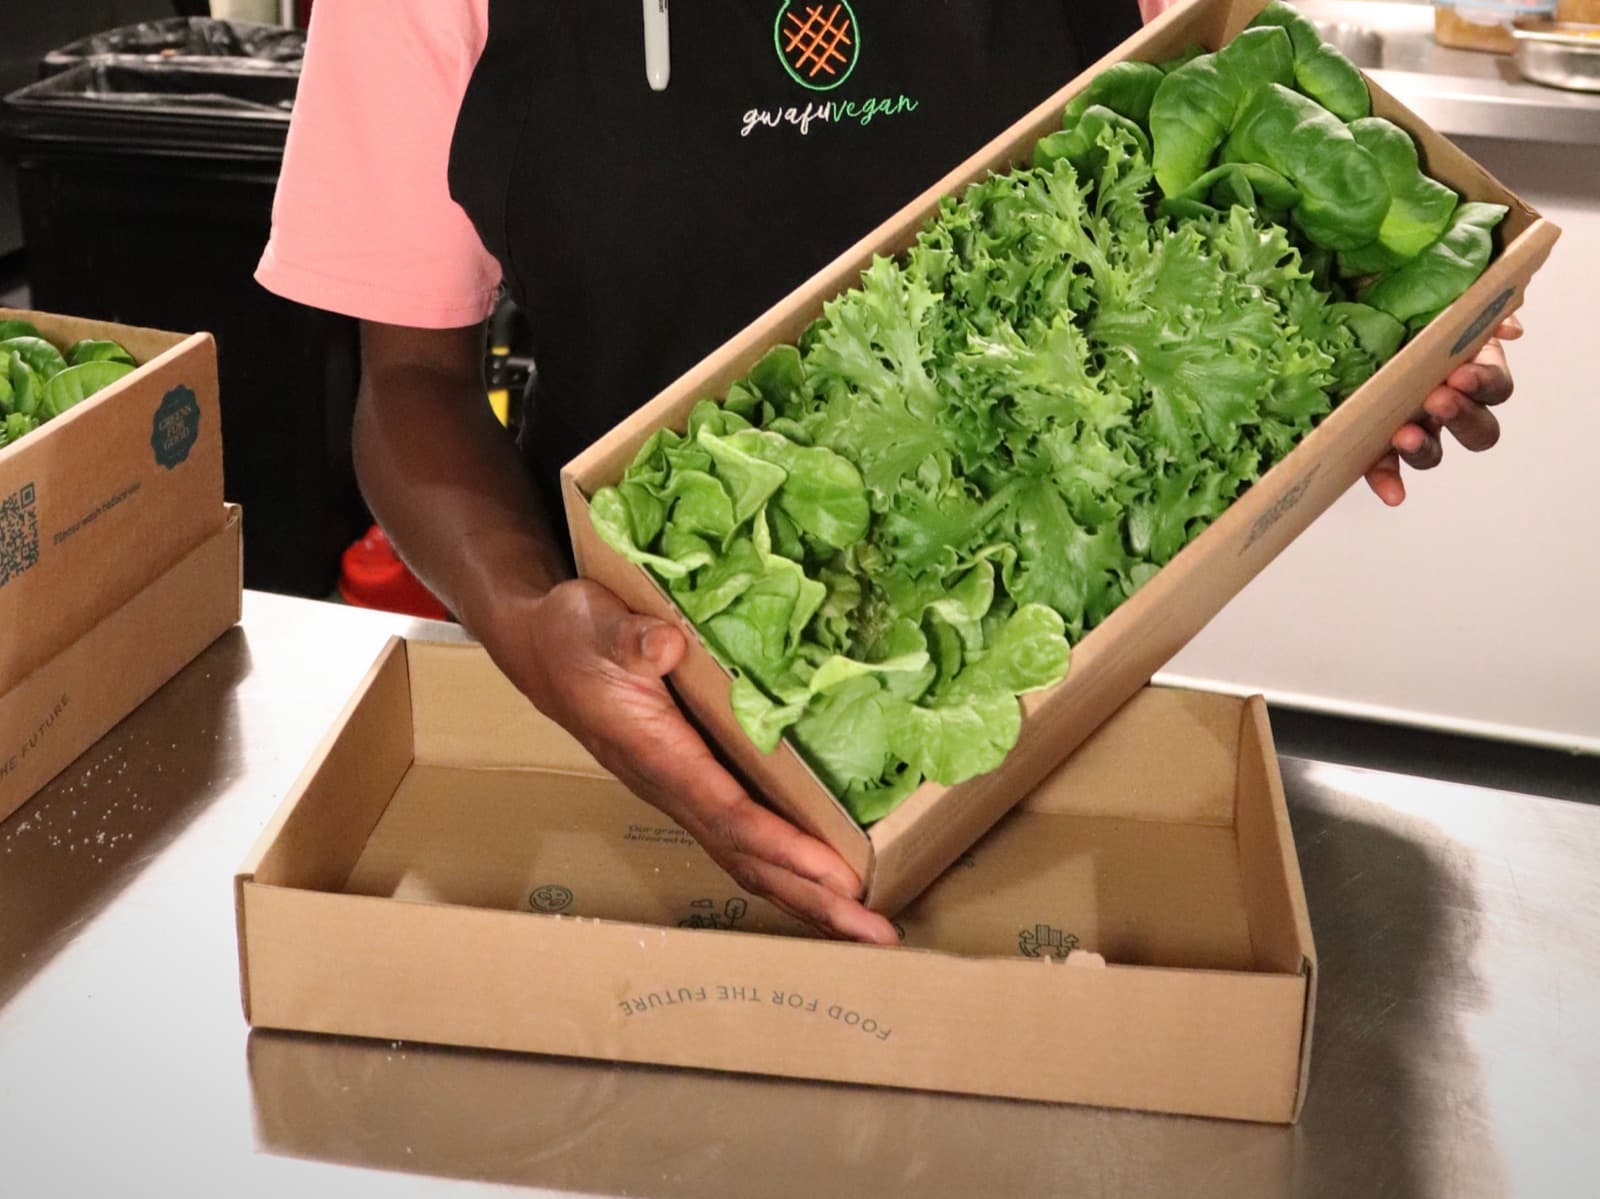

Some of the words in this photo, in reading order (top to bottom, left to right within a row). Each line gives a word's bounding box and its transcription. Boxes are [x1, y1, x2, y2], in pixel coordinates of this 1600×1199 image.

[21, 692, 69, 759] FUTURE
[617, 986, 707, 1017] FUTURE
[716, 985, 761, 1002] THE
[771, 989, 819, 1013] FOR
[827, 1004, 893, 1041] FOOD
